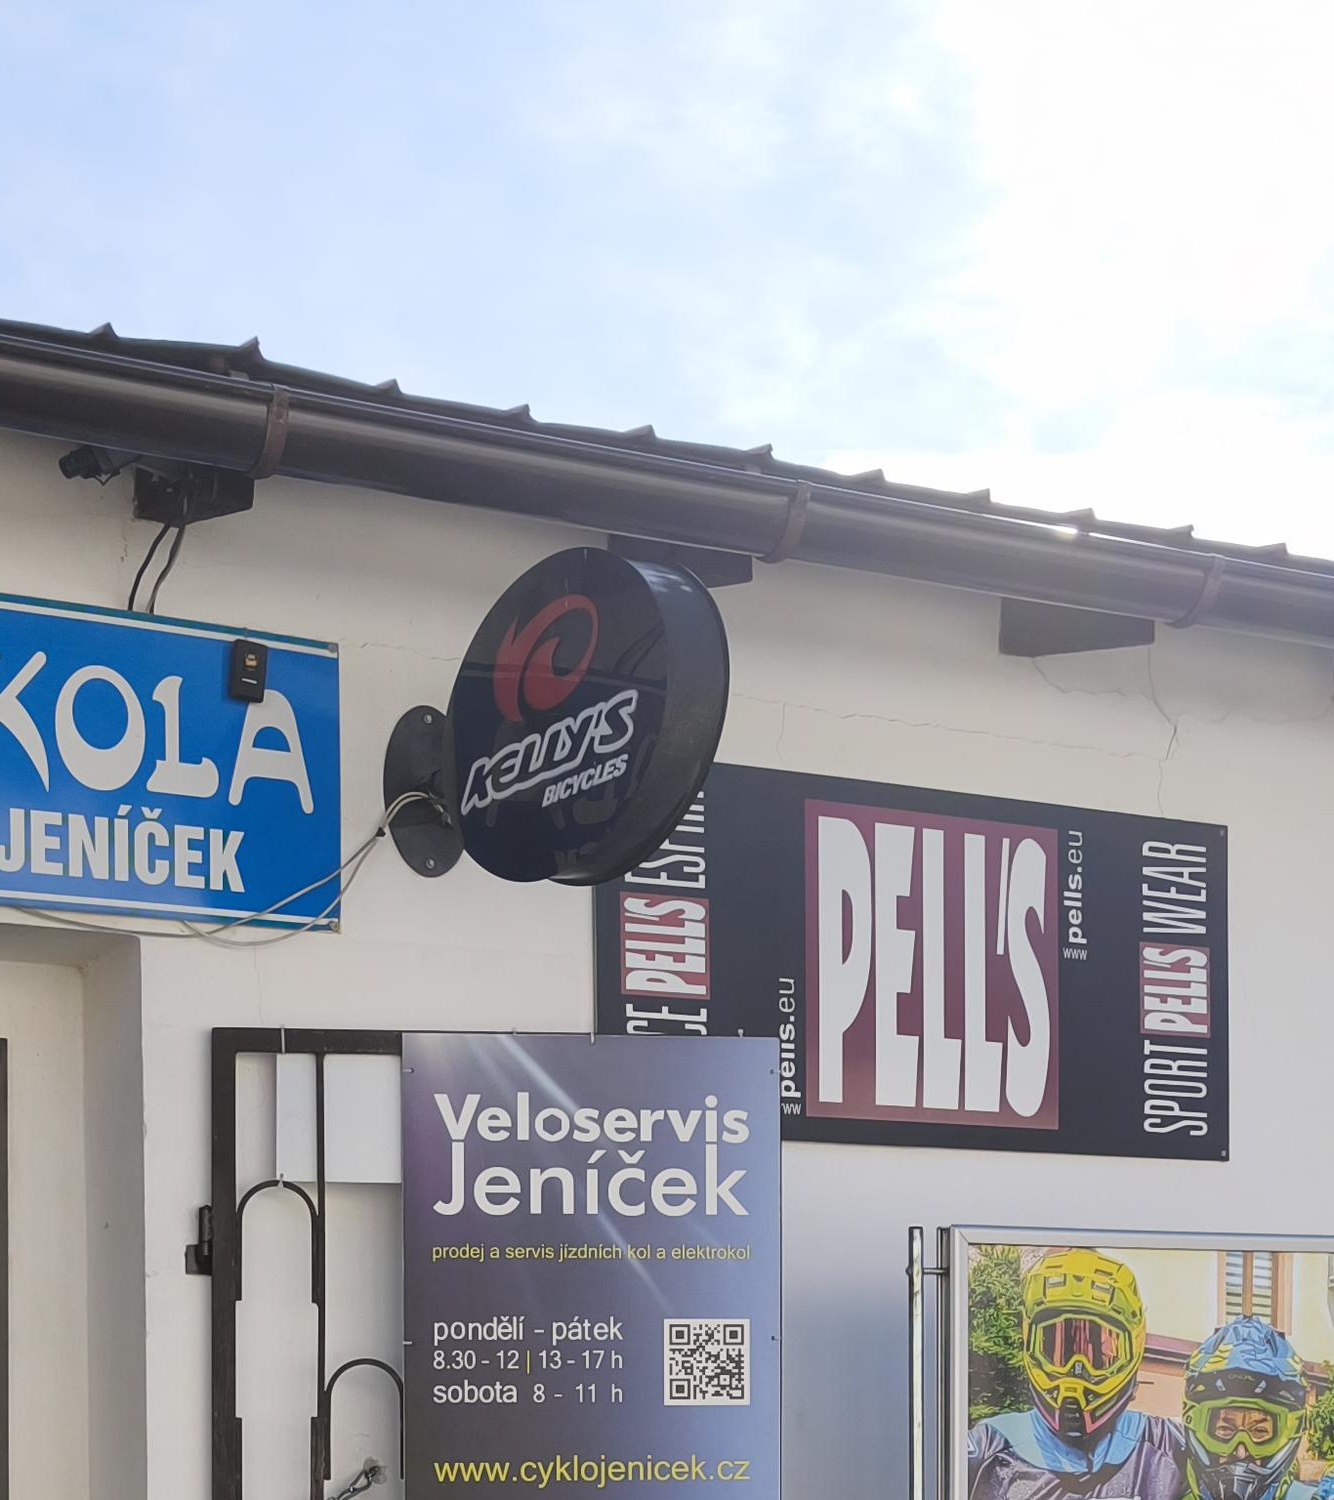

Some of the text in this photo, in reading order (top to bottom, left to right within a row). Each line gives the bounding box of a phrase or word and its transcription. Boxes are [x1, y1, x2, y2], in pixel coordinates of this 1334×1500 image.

[542, 753, 629, 808] BICYCLES
[816, 814, 1052, 1119] PELL'S
[1142, 840, 1209, 1136] SPORT PELL'S WEAR
[433, 1091, 750, 1144] Veloservis
[432, 1142, 750, 1217] Jeníček
[432, 1242, 751, 1263] prodej a servis jízdních kol a elektrokol
[433, 1316, 525, 1345] pondělí
[551, 1316, 624, 1345] pátek
[433, 1350, 477, 1370] 8.30
[495, 1350, 520, 1370] 12
[538, 1350, 563, 1370] 13
[581, 1350, 605, 1370] 17
[611, 1350, 624, 1370] h
[433, 1380, 518, 1404] sobota
[532, 1384, 546, 1404] 8
[575, 1384, 597, 1404] 11
[611, 1384, 624, 1404] h
[434, 1455, 751, 1489] www.cyklojenicek.cz
